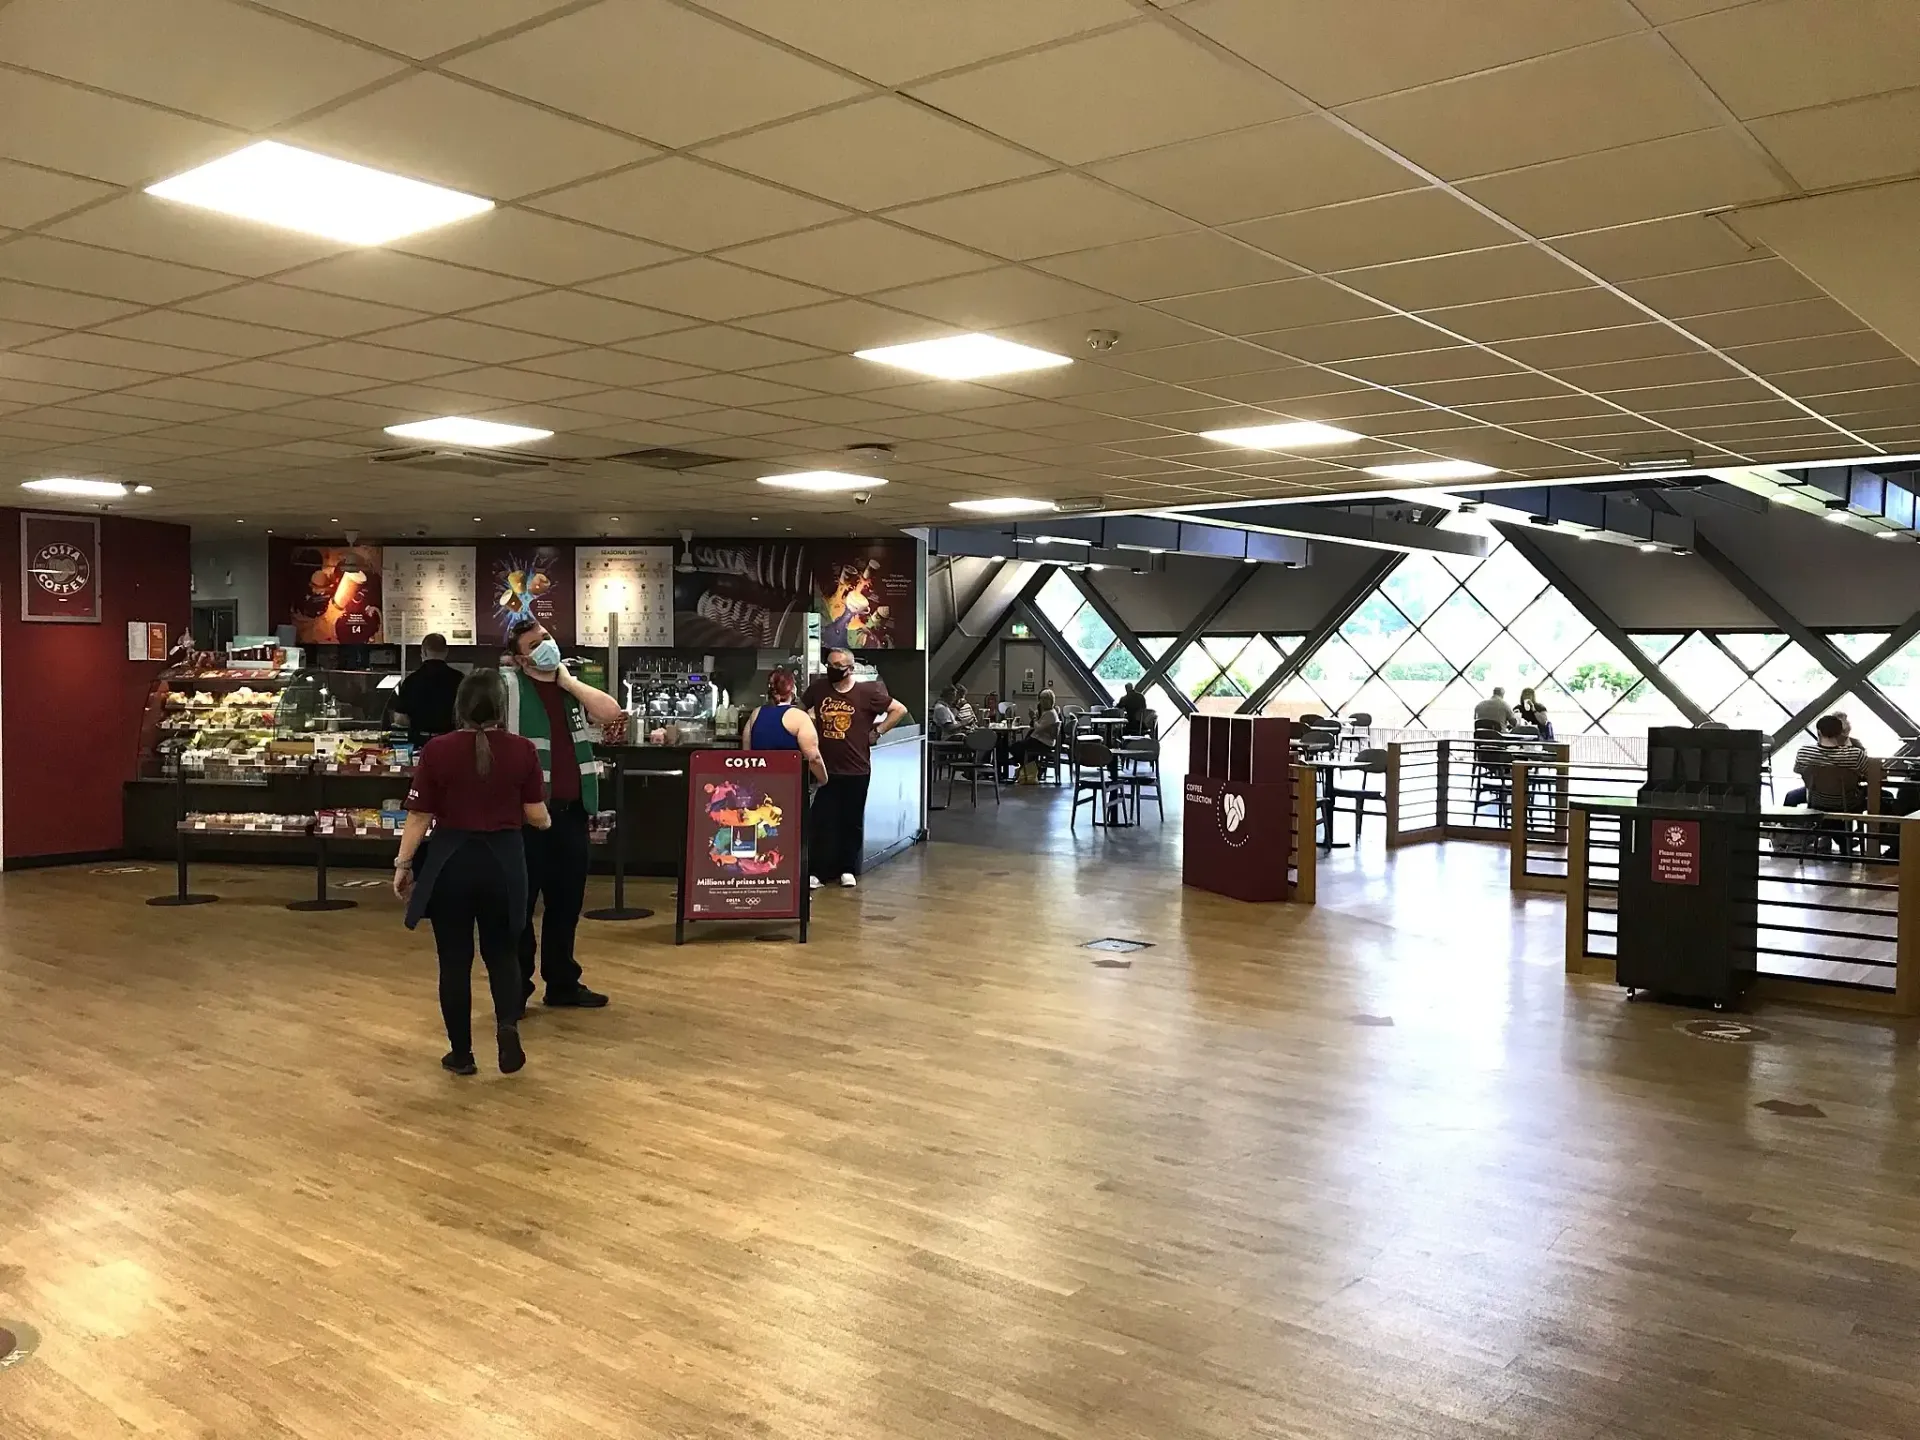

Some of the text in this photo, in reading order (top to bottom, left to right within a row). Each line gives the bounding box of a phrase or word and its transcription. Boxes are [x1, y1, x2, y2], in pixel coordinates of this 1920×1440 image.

[42, 546, 80, 561] COSTA
[38, 574, 85, 593] COFFEE
[820, 697, 856, 715] Eagles
[725, 758, 766, 768] COSTA
[1186, 784, 1202, 793] COFFEE
[1186, 794, 1212, 804] COLLECTION
[1667, 838, 1685, 847] COFFEE
[736, 878, 756, 887] prizes
